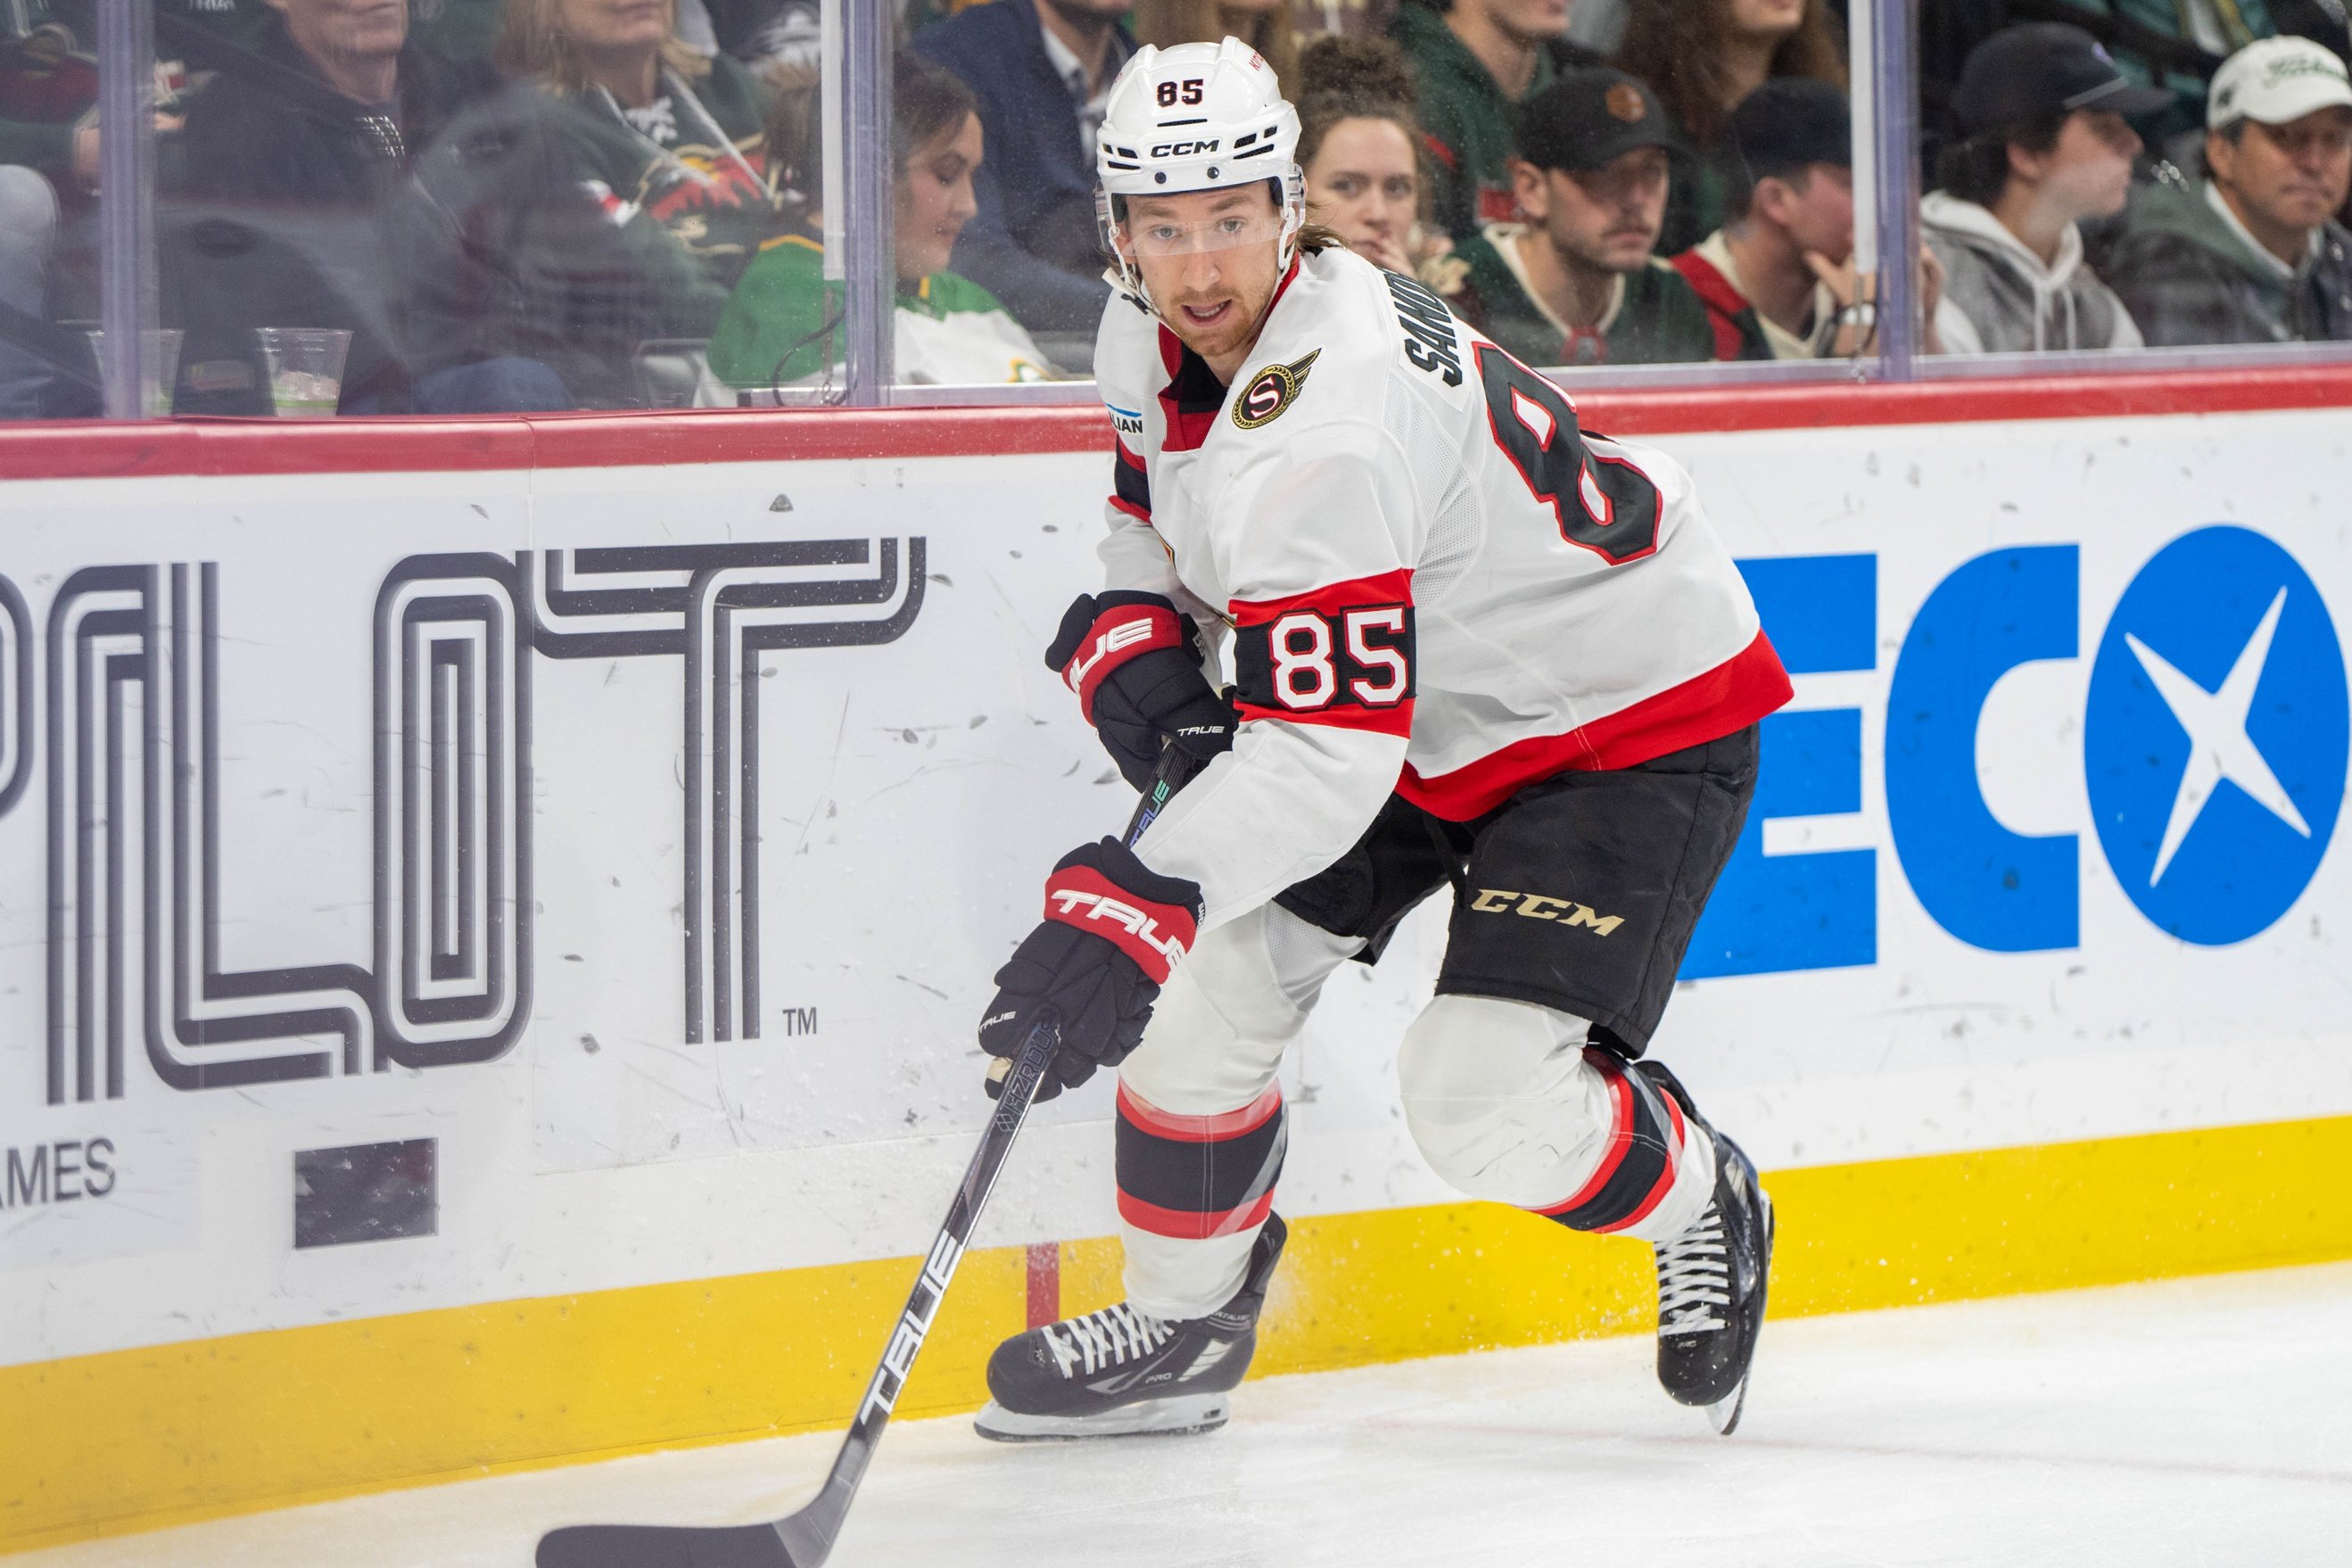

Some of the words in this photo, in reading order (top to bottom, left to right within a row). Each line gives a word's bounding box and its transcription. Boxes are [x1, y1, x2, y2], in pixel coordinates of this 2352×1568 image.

[1157, 78, 1203, 108] 85
[1151, 139, 1219, 158] CCM
[1383, 268, 1463, 387] SAND
[1471, 341, 1663, 565] 8
[1267, 602, 1409, 713] 85
[1177, 726, 1225, 737] TRUE
[1129, 780, 1170, 847] TRUE
[1472, 889, 1625, 937] CCM
[782, 1007, 817, 1036] TM
[0, 1138, 116, 1209] MES
[860, 1228, 964, 1426] TRUE
